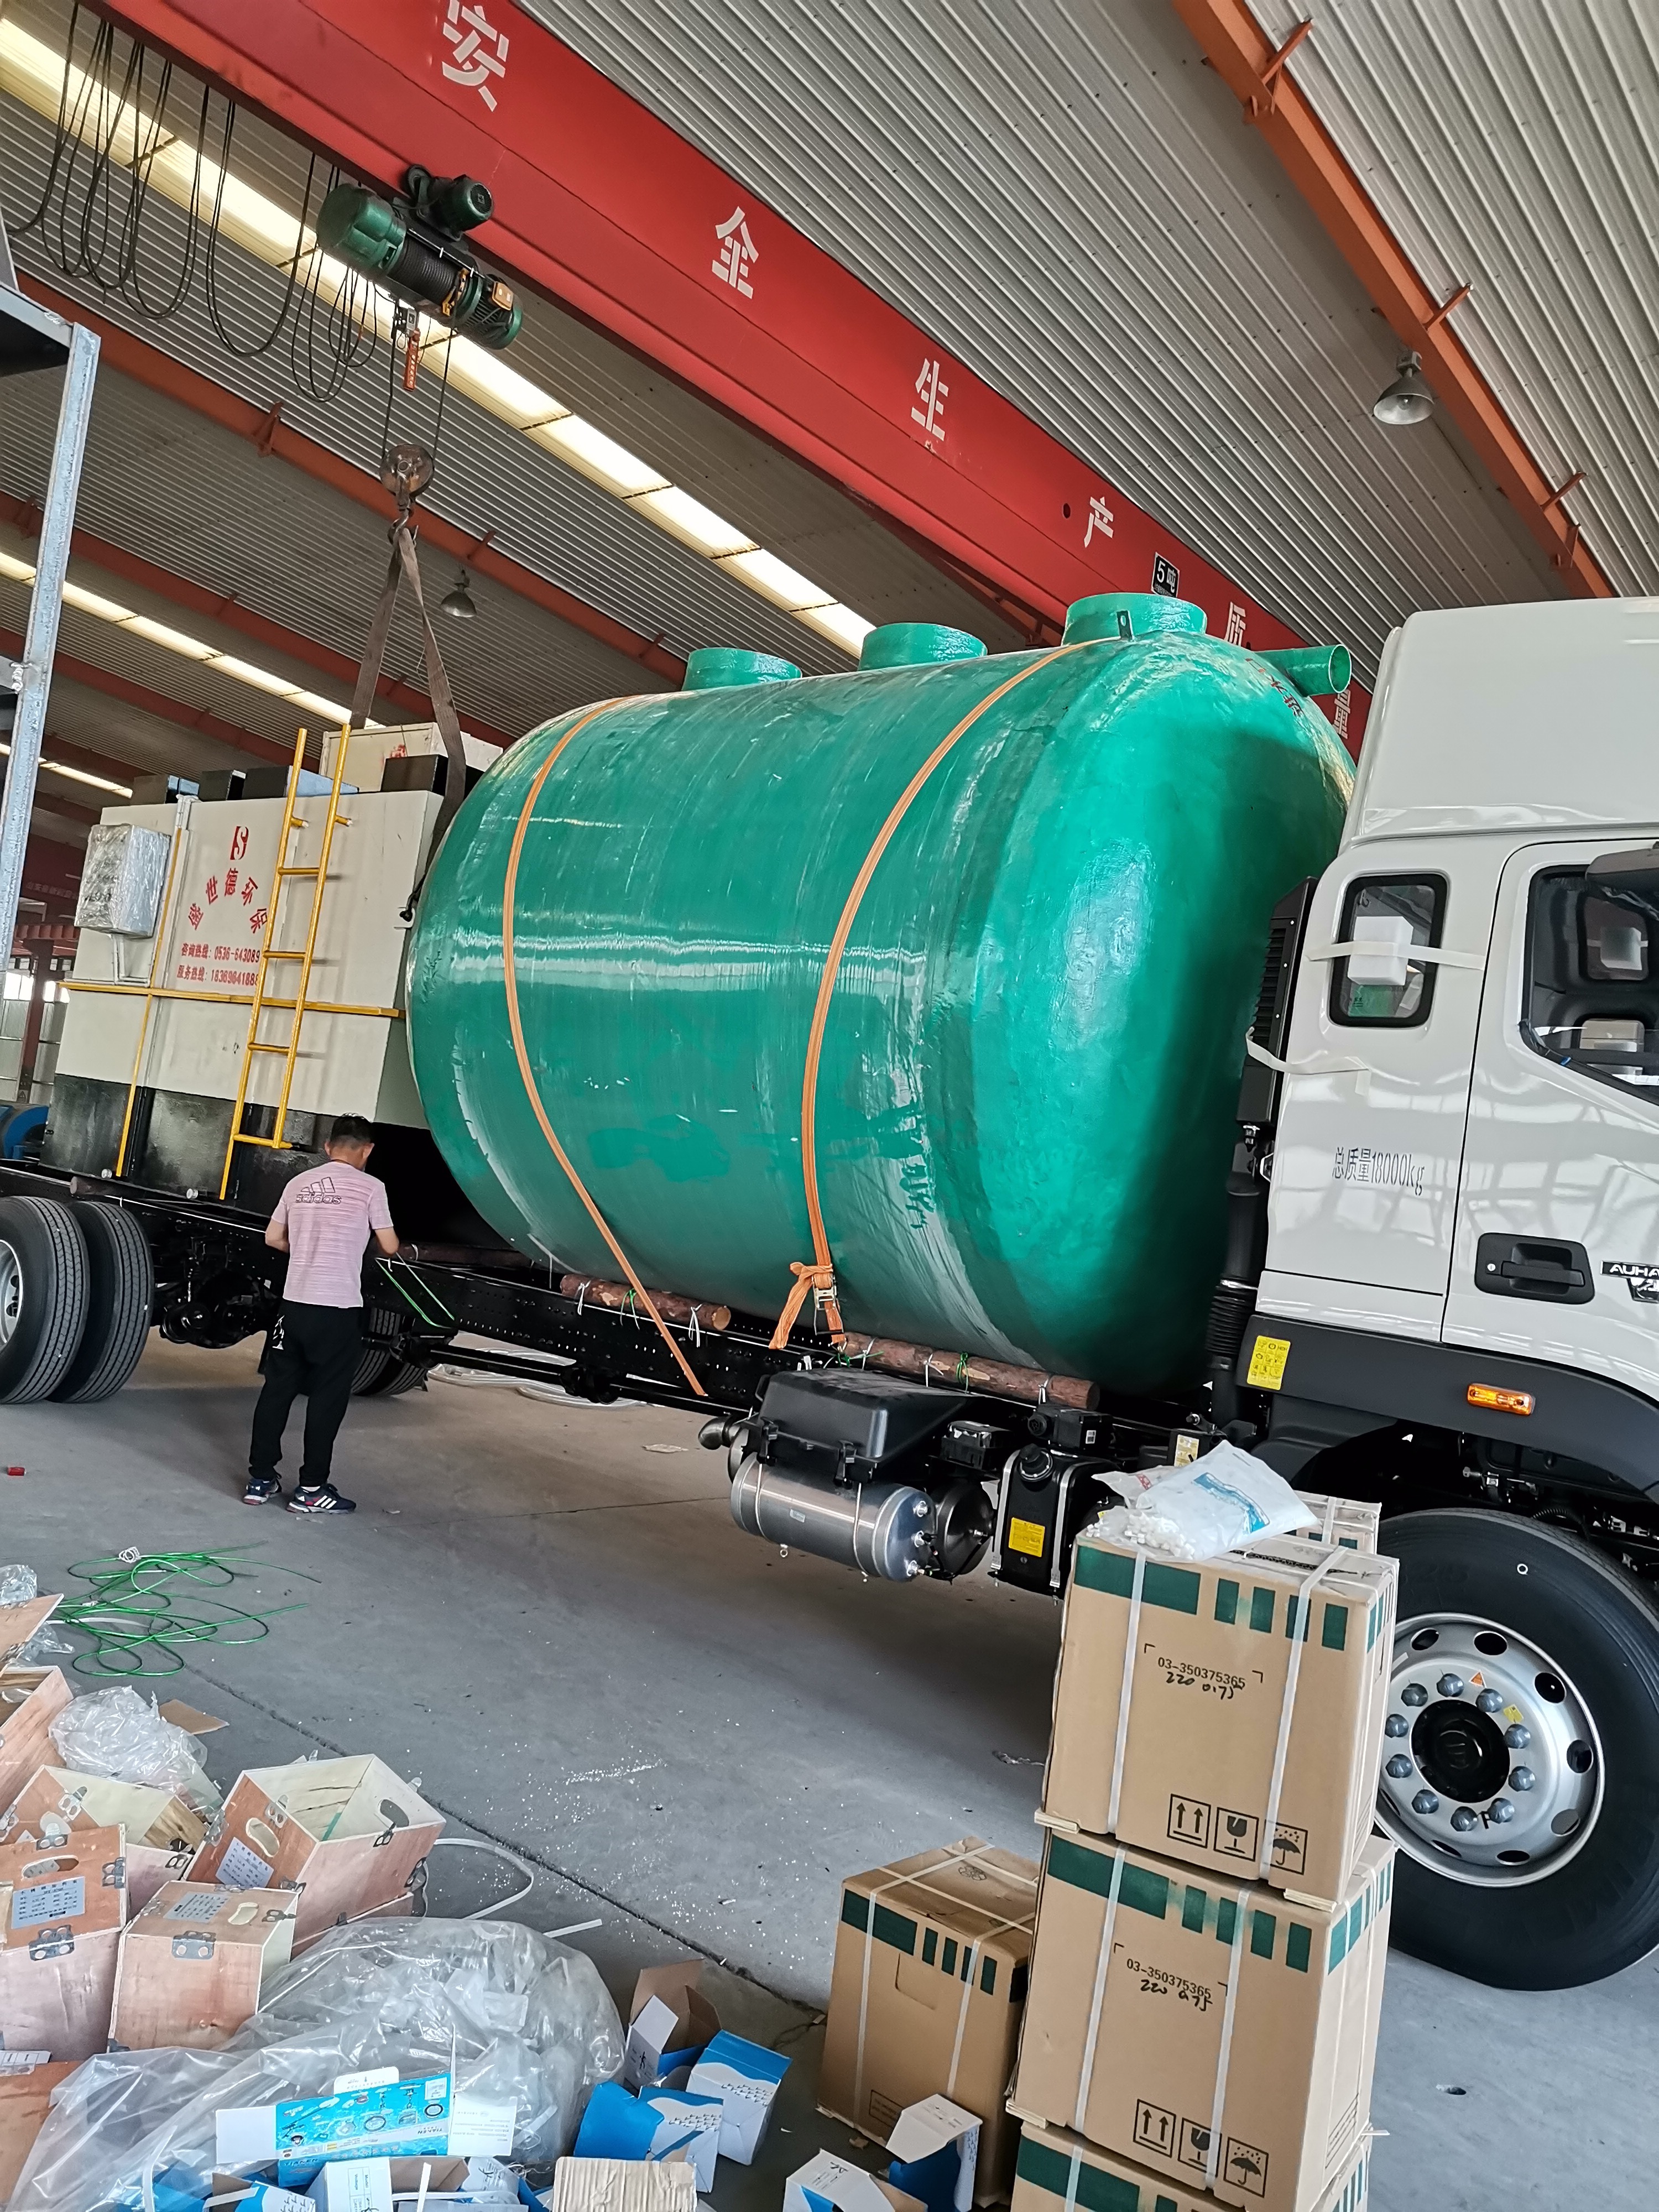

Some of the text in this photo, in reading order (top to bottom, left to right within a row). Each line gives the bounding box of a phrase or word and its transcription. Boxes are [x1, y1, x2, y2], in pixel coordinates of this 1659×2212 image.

[295, 1191, 342, 1205] adidas
[1157, 1657, 1246, 1688] 03-350375365
[1126, 1958, 1212, 2000] 03-350375365
